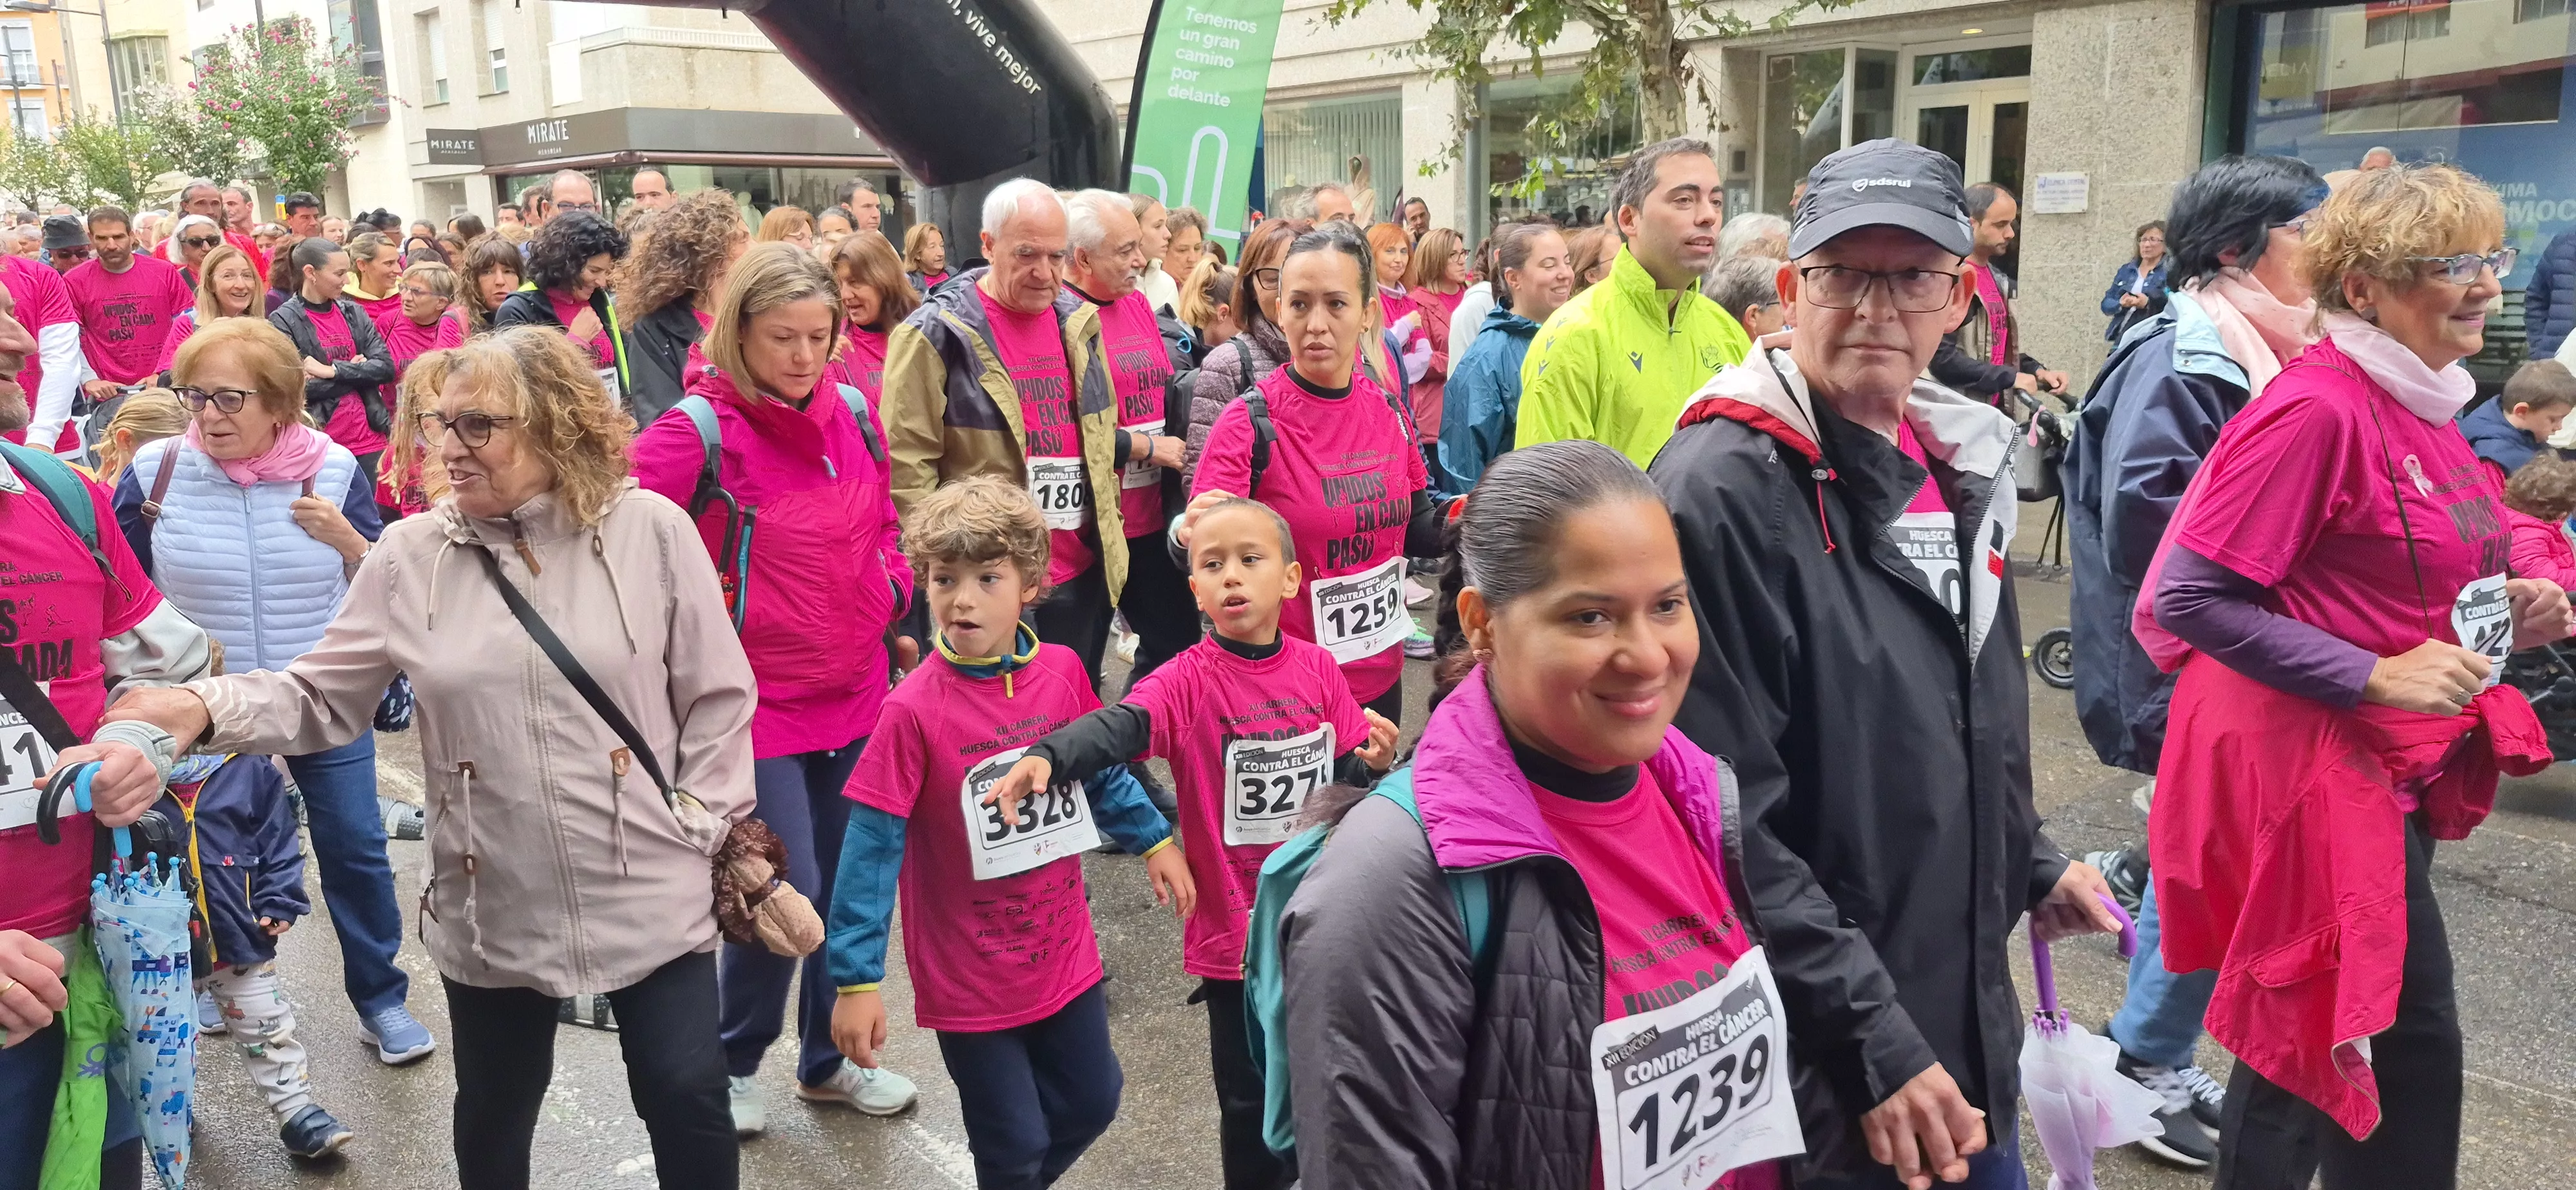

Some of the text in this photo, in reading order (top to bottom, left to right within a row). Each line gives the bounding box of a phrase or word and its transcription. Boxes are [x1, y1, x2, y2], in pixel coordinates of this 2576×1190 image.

[1186, 6, 1257, 33] Tenemos
[1180, 29, 1240, 50] un gran
[965, 10, 996, 48] vive
[995, 46, 1042, 94] mejor
[1175, 48, 1235, 68] camino
[1170, 66, 1200, 82] por
[1168, 84, 1231, 107] delante
[527, 119, 570, 144] MIRATE
[430, 139, 475, 150] MIRATE
[1037, 401, 1057, 428] EN
[1124, 392, 1155, 419] PASO
[1039, 472, 1069, 480] CONTRA
[1321, 471, 1387, 508] UNIDOS
[1354, 503, 1376, 534] EN
[1909, 530, 1953, 542] HUESCA
[1327, 534, 1375, 570] PASO
[1924, 544, 1944, 558] EL
[19, 569, 64, 585] CÁNCER
[1325, 573, 1397, 604] CONTRA EL CÁNCER
[1358, 576, 1380, 590] HUESCA
[1327, 587, 1398, 638] 1259
[1253, 710, 1287, 722] CONTRA
[1289, 708, 1298, 717] EL
[1260, 697, 1299, 710] CARRERA
[0, 711, 28, 726] NCE
[994, 713, 1048, 737] XII CARRERA
[959, 739, 999, 757] HUESCA
[1001, 729, 1038, 746] CONTRA
[1039, 726, 1048, 737] EL
[1281, 745, 1311, 759] HUESCA
[1242, 749, 1264, 758] EDICIÓN
[1242, 759, 1289, 772] CONTRA
[1291, 757, 1303, 767] EL
[980, 779, 1077, 842] 3328
[1624, 998, 1768, 1086] CONTRA EL CÁNCER
[1627, 1033, 1769, 1169] 1239
